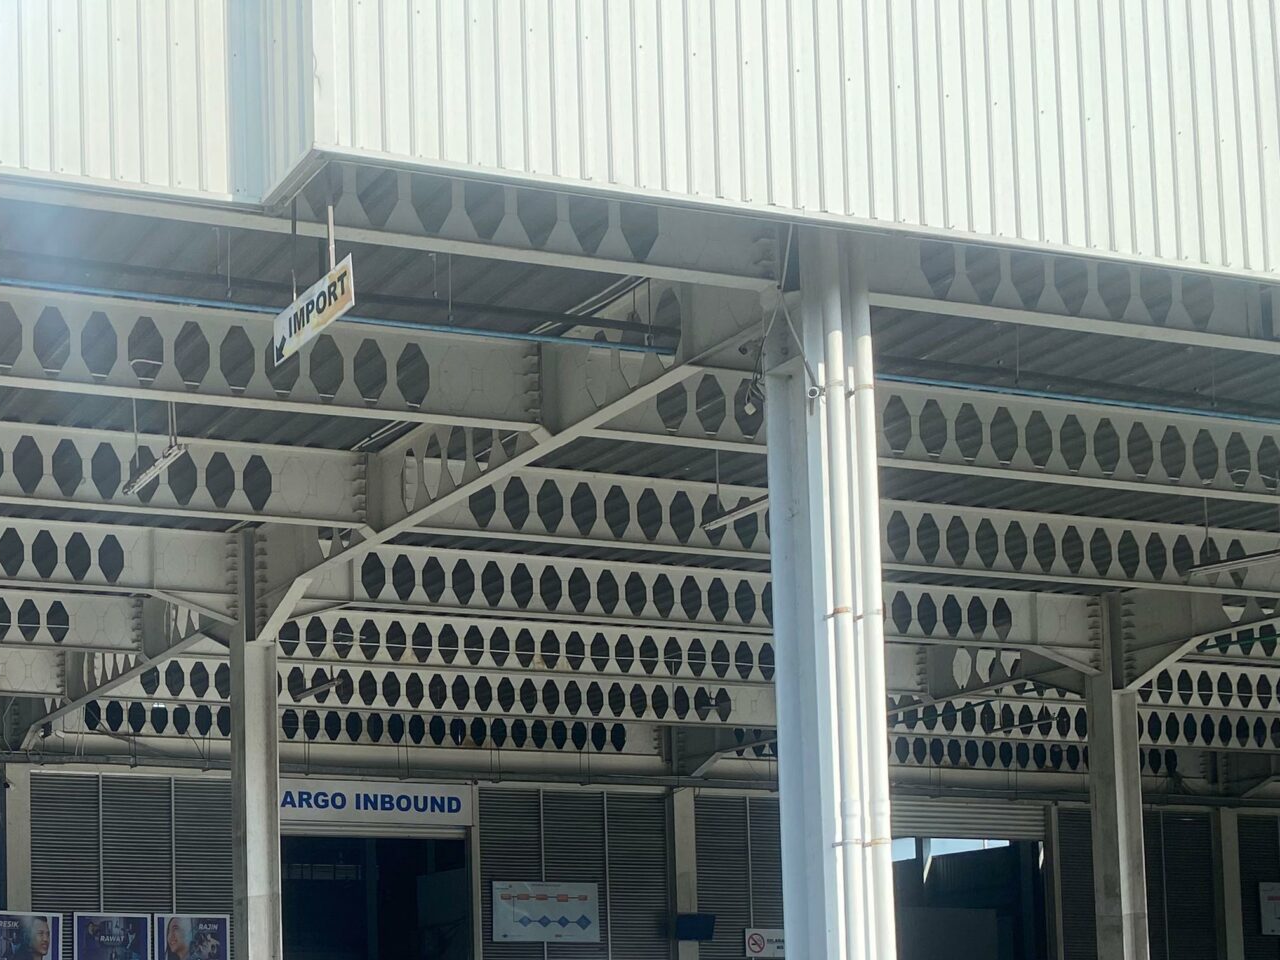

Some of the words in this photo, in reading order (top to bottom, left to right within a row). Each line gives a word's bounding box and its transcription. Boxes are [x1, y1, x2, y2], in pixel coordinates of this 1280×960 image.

[288, 271, 348, 338] IMPORT
[280, 790, 347, 809] ARGO
[355, 793, 462, 813] INBOUND
[198, 923, 219, 931] RAJIN
